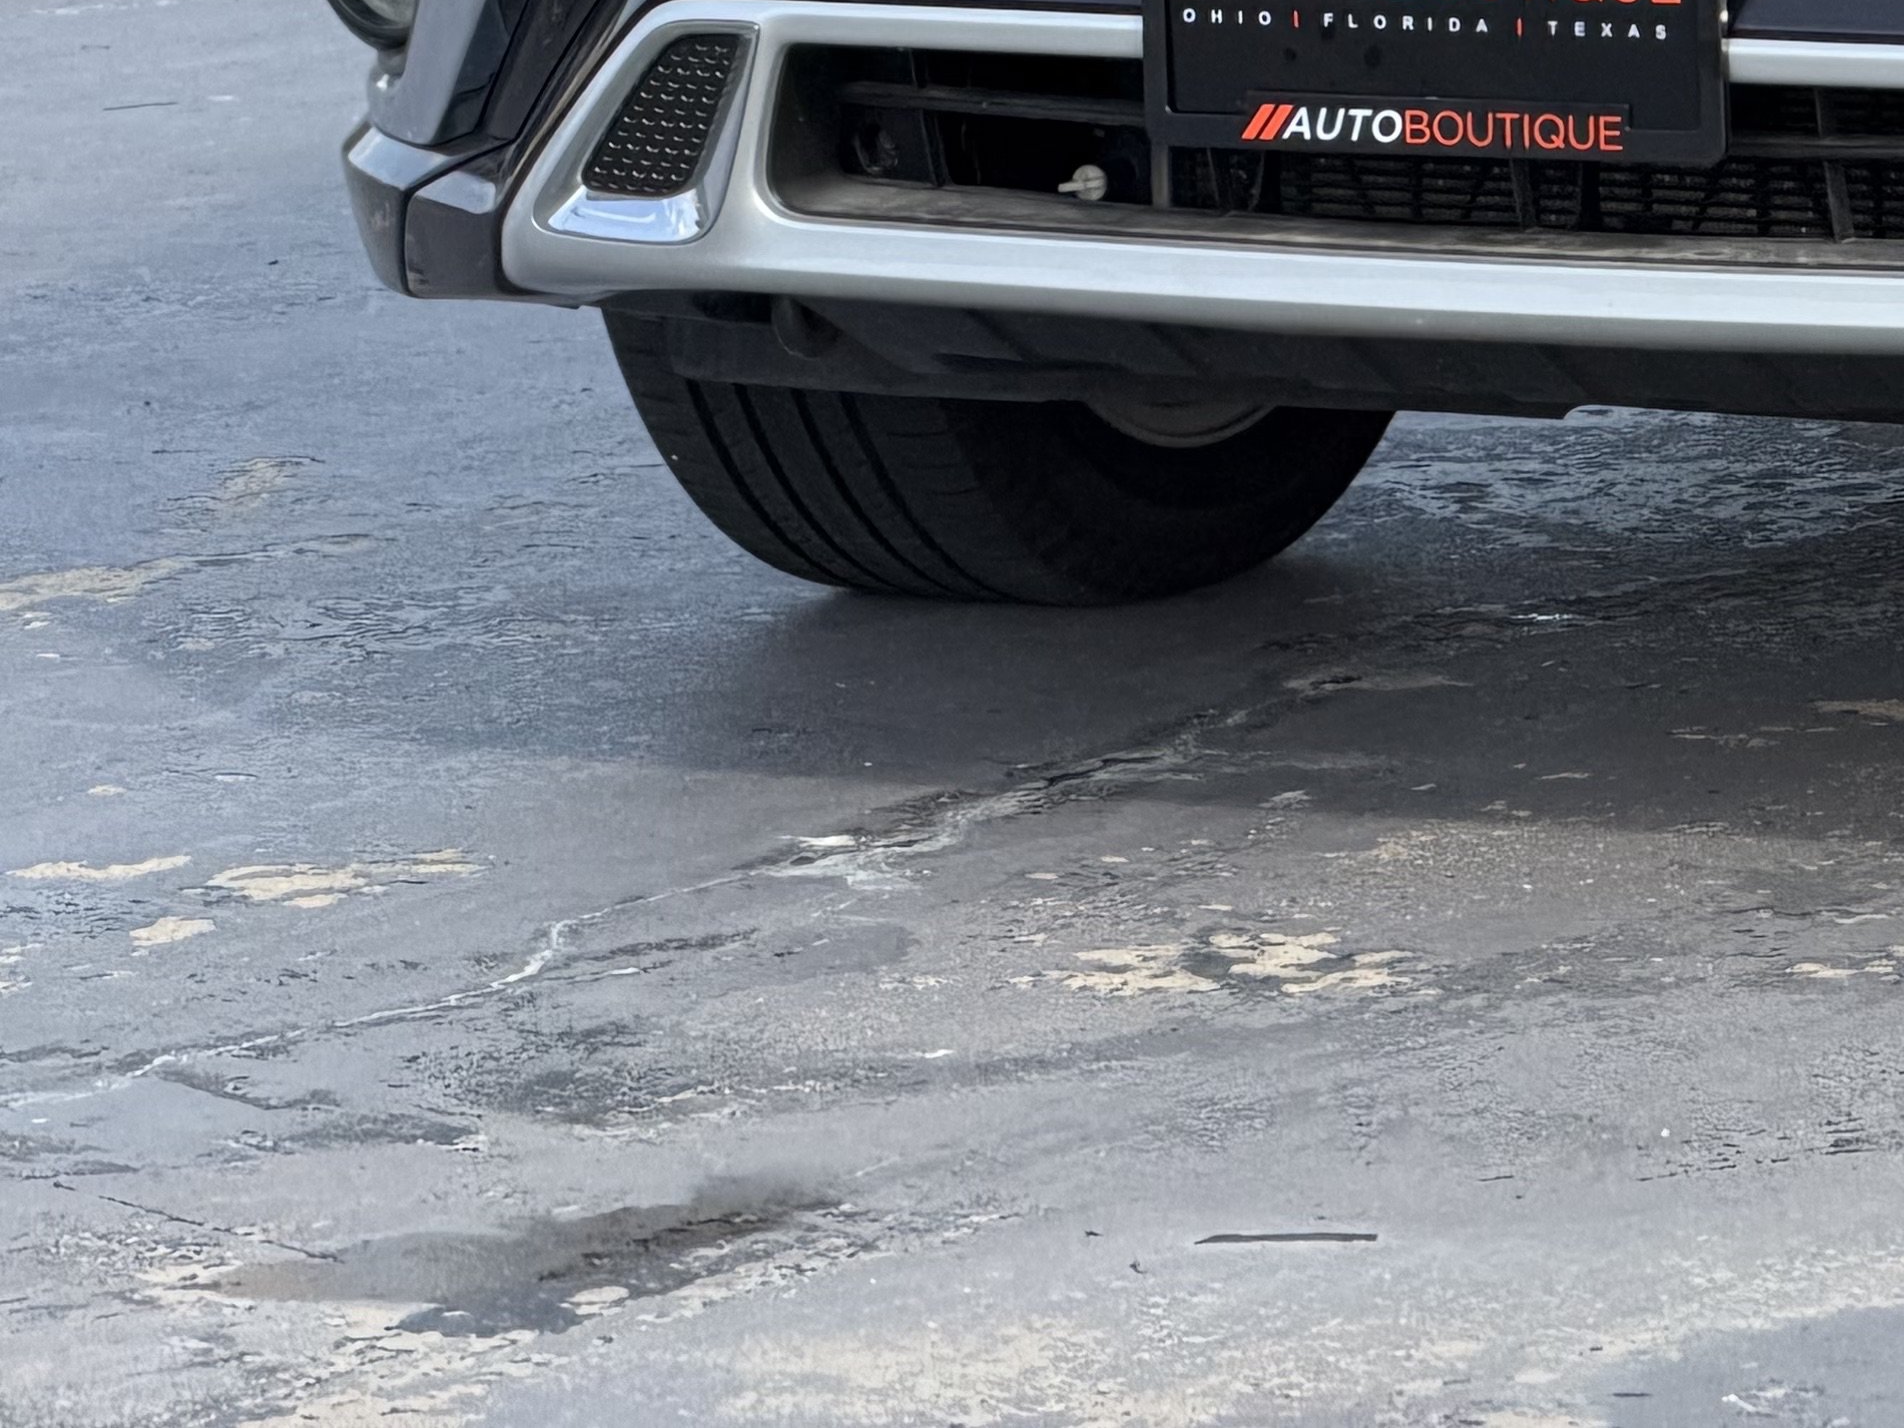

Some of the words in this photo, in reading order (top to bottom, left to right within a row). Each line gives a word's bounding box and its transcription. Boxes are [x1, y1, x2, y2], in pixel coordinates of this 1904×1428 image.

[1182, 7, 1272, 26] OHIO
[1323, 12, 1489, 33] FLORIDA
[1547, 20, 1667, 41] TEXAS
[1282, 108, 1624, 151] AUTOBOUTIQUE
